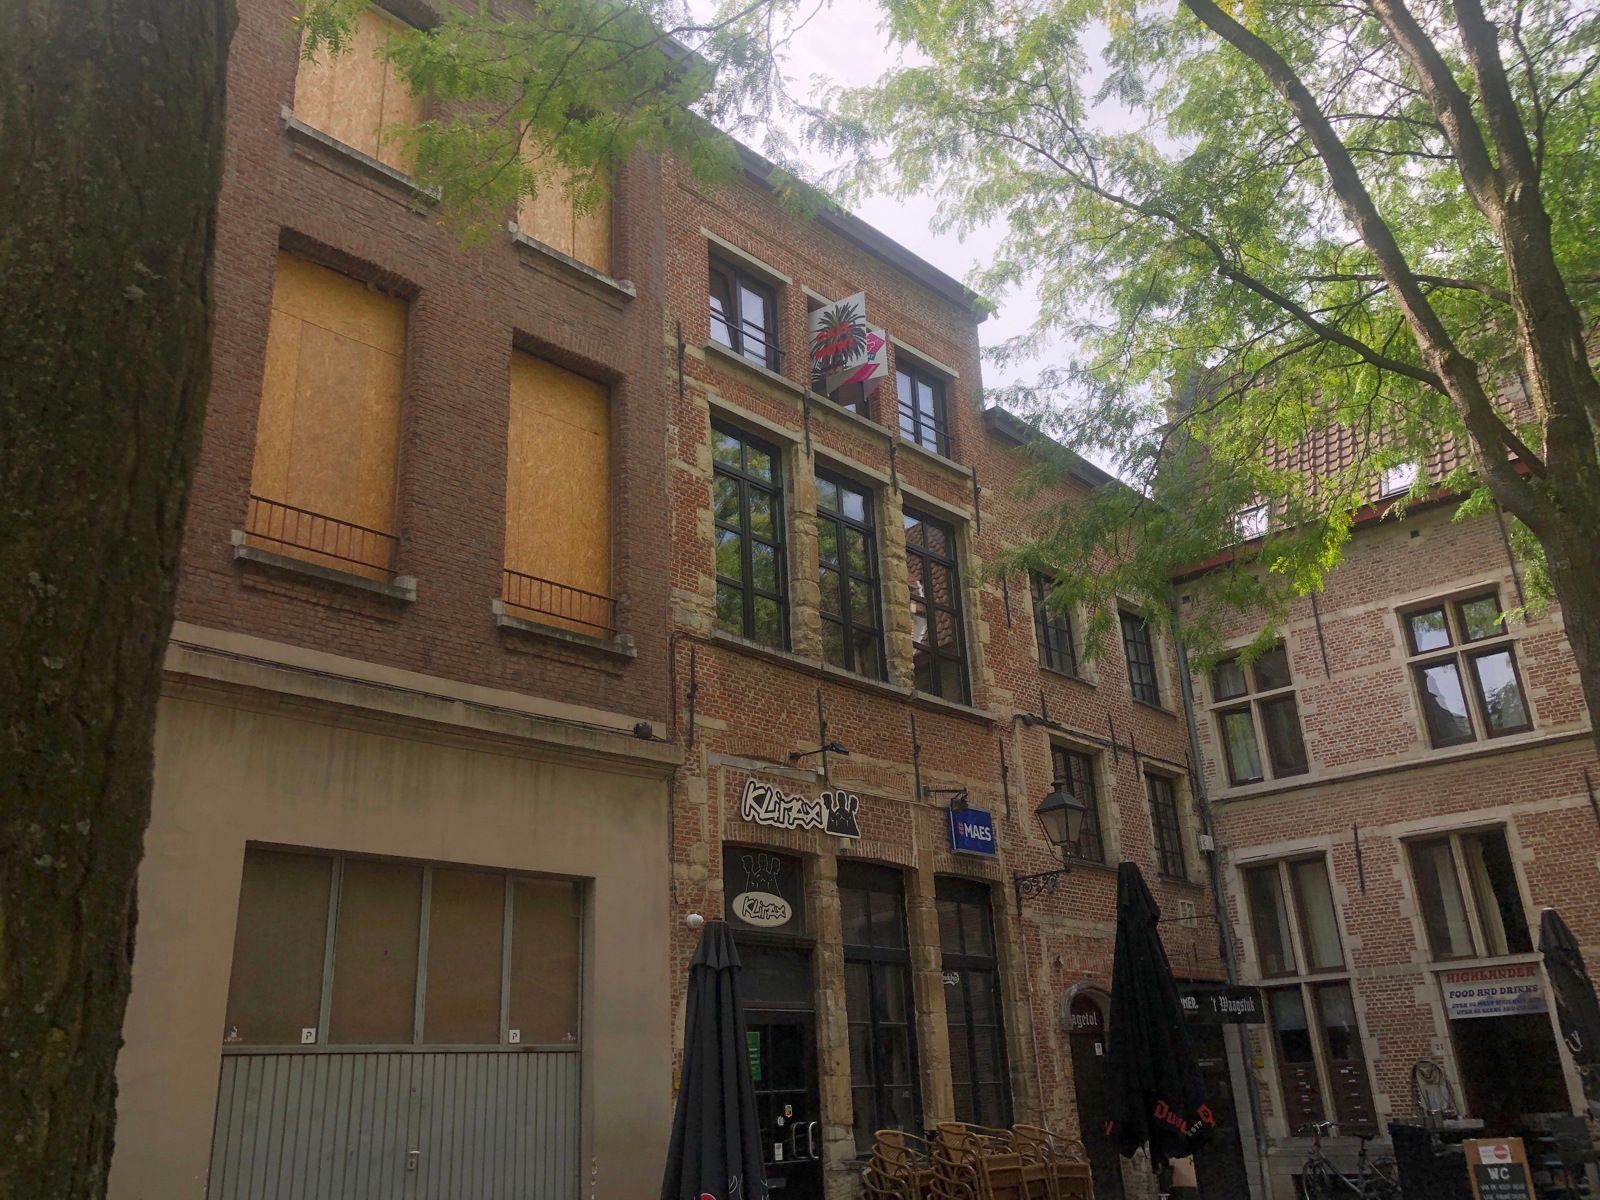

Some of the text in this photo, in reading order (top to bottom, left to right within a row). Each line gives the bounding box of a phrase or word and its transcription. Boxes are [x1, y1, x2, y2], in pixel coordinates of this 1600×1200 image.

[964, 823, 992, 841] MAES
[1446, 967, 1536, 983] HIGHLANDER
[1449, 984, 1539, 999] FOOD AND DRINKS
[1218, 995, 1255, 1015] Waagstuk
[1487, 1167, 1511, 1180] WC
